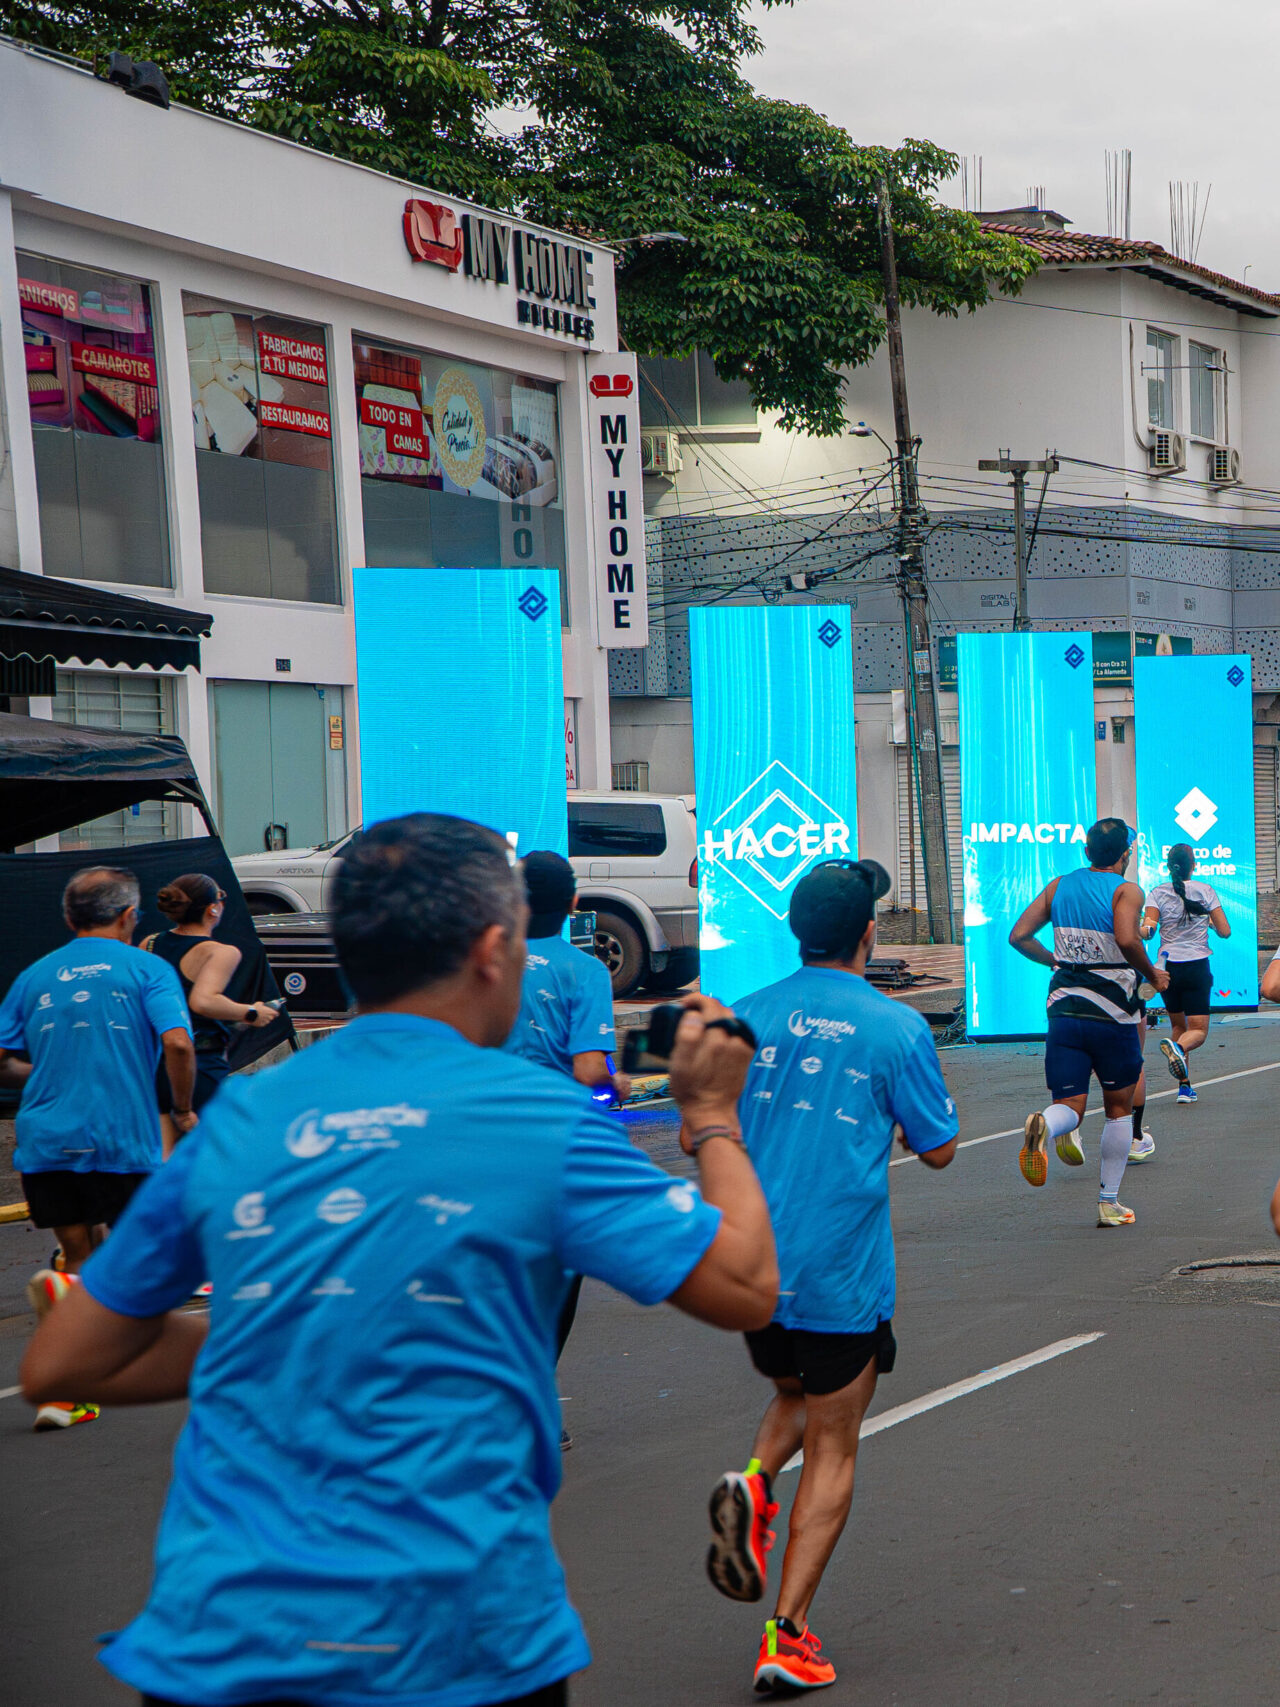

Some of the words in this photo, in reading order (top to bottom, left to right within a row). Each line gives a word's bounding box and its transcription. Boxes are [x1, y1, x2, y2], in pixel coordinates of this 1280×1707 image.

[462, 214, 511, 284] MY
[513, 230, 597, 310] HOME
[262, 334, 325, 363] FABRICAMOS
[81, 349, 151, 379] CAMAROTES
[263, 355, 271, 371] A
[272, 356, 286, 374] TU
[288, 360, 326, 382] MEDIDA
[261, 404, 329, 432] RESTAURAMOS
[369, 404, 397, 424] TODO
[399, 411, 412, 428] EN
[442, 409, 467, 433] Calidad
[393, 434, 423, 453] CAMAS
[600, 414, 628, 478] MY
[606, 490, 635, 629] HOME
[704, 822, 851, 861] HACER
[971, 822, 1088, 844] IMPACTA
[1212, 844, 1232, 859] de
[277, 867, 314, 875] NATIVA
[1061, 933, 1095, 945] POWER
